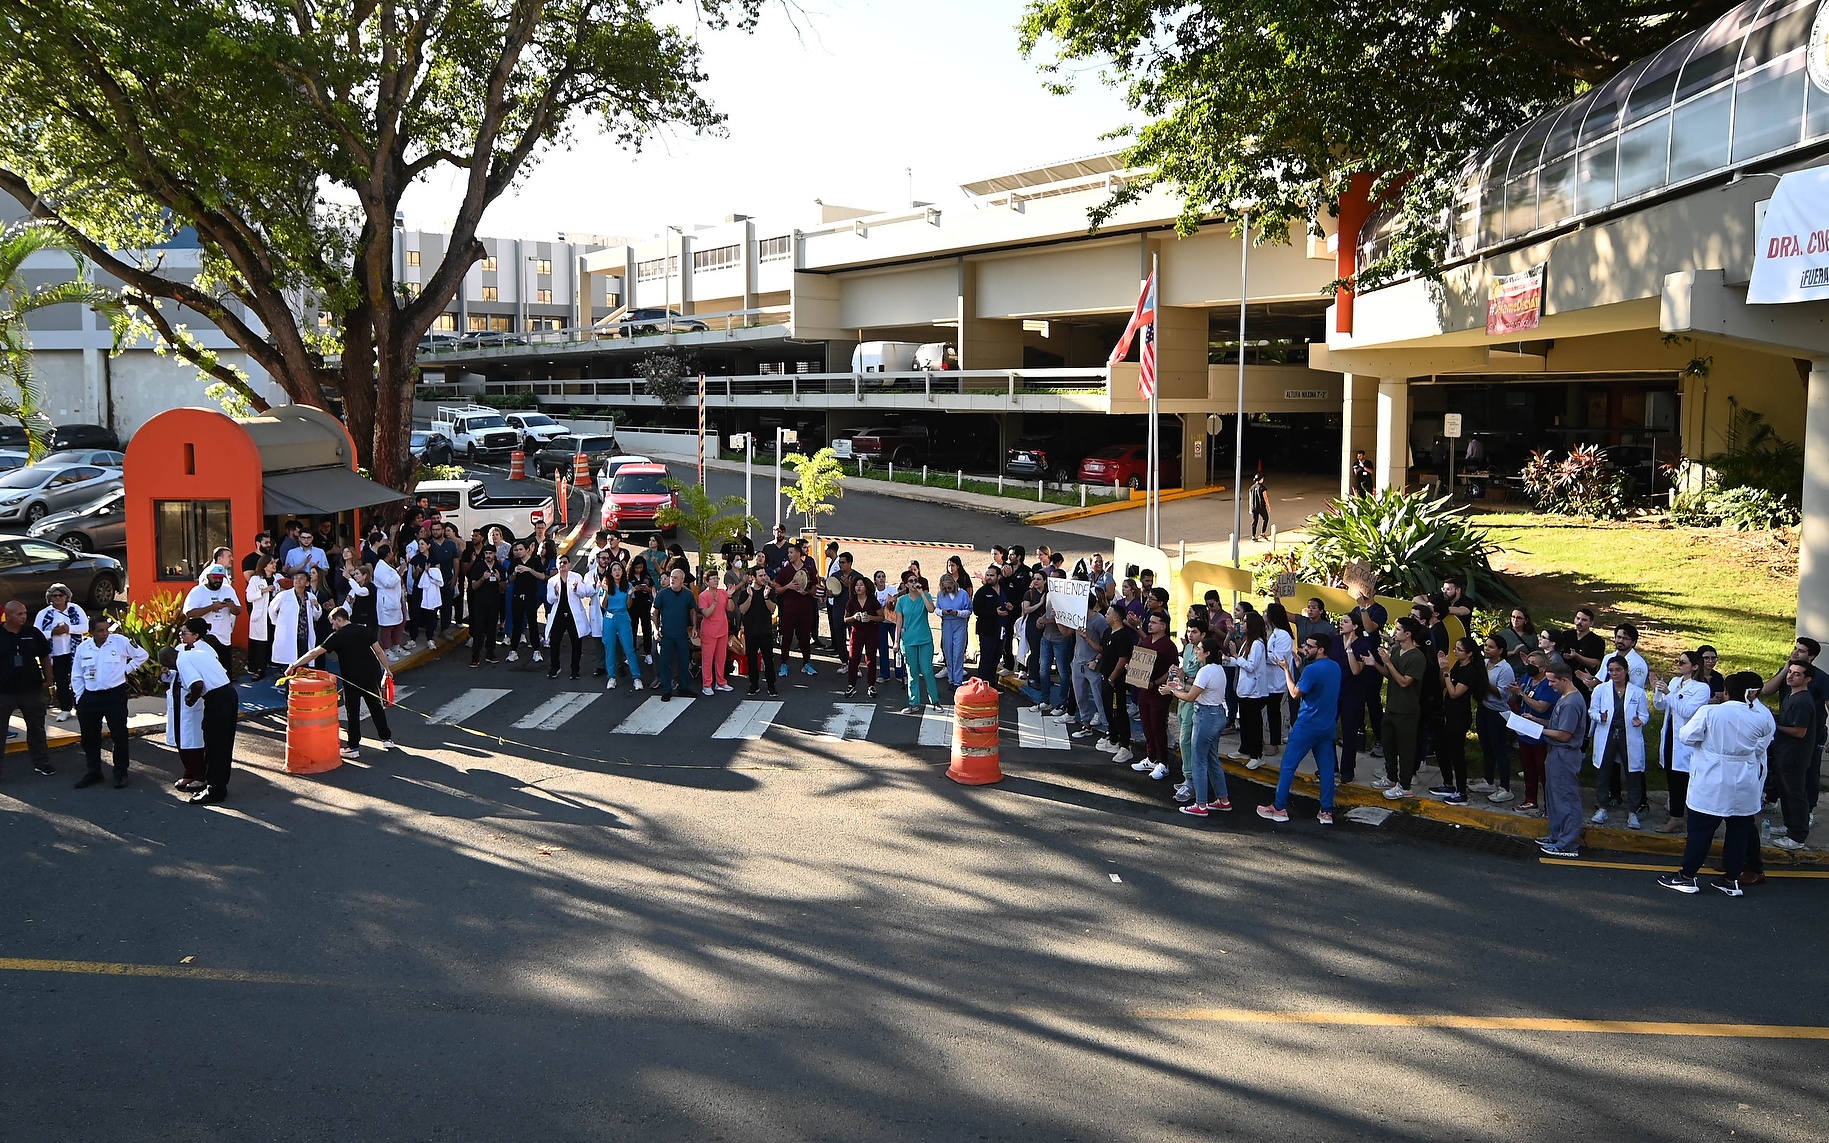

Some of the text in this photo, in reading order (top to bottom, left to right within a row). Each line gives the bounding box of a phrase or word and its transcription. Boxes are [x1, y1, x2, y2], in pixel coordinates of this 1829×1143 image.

[1767, 235, 1803, 259] DRA.
[1277, 572, 1296, 584] ILKA
[1048, 580, 1090, 597] DEFIENDE
[1131, 651, 1156, 666] DOCTORA
